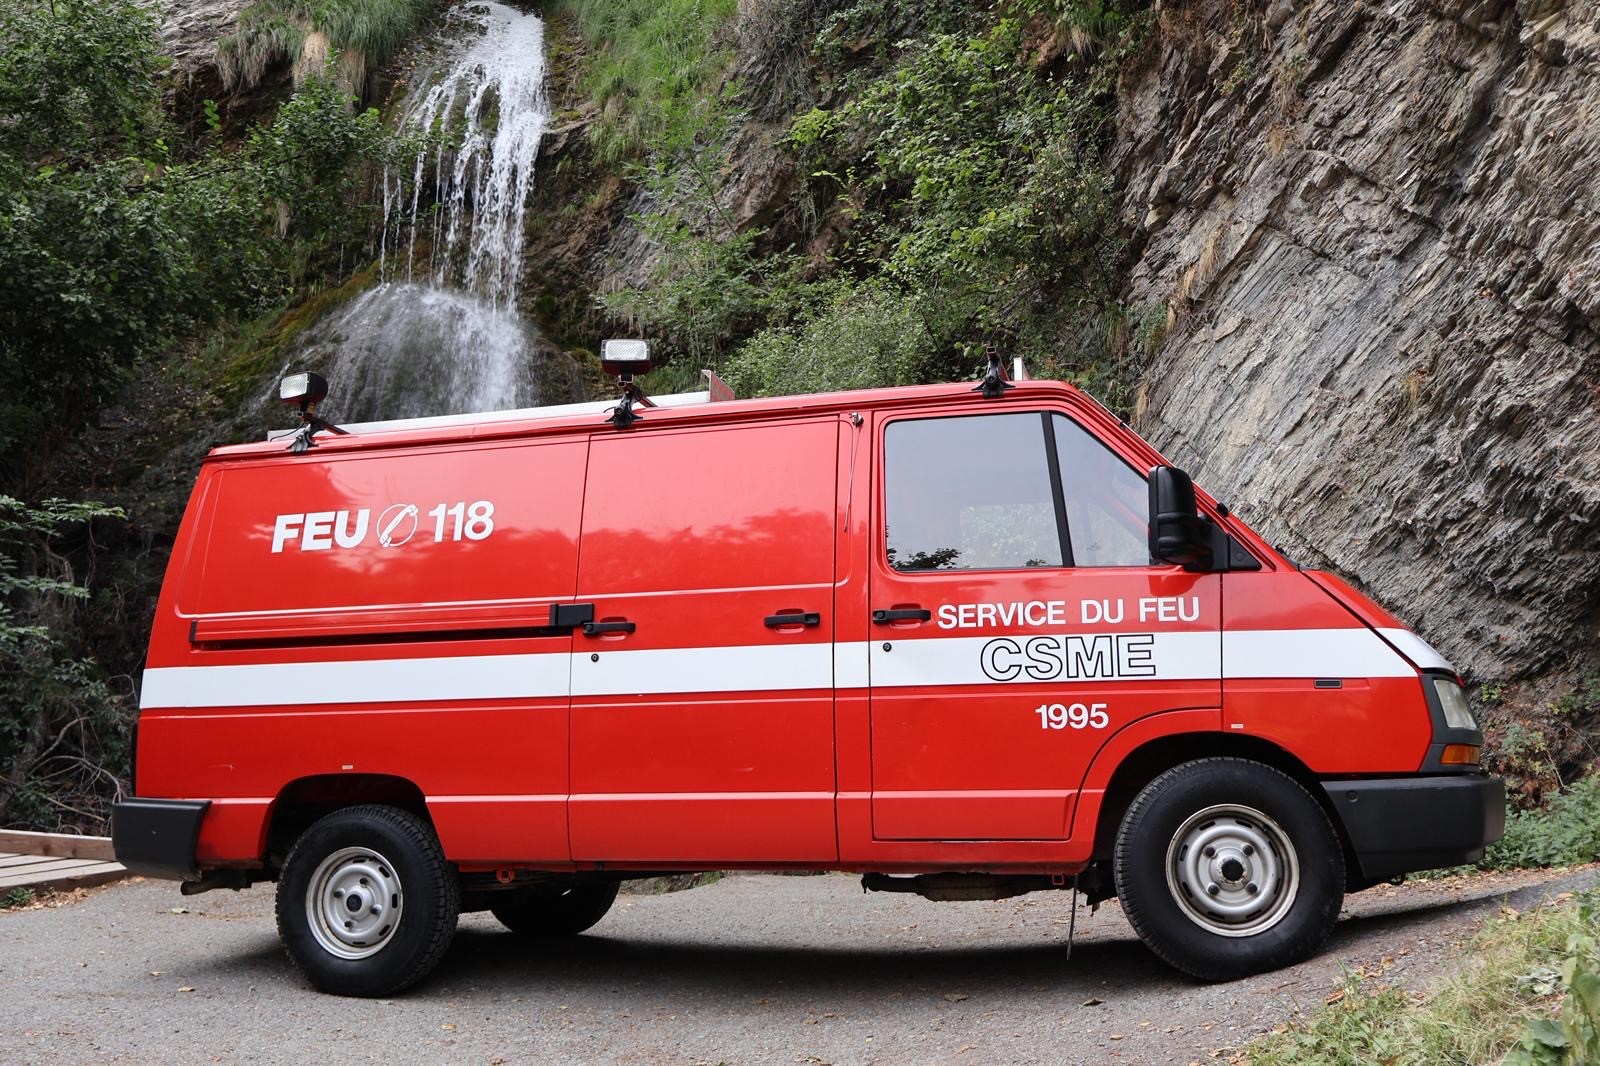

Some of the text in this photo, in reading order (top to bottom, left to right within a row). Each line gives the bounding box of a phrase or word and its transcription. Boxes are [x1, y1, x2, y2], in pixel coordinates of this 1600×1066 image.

[271, 500, 495, 554] FEU 118
[937, 596, 1200, 630] SERVICE DU FEU
[980, 633, 1157, 682] CSME
[1035, 703, 1109, 730] 1995
